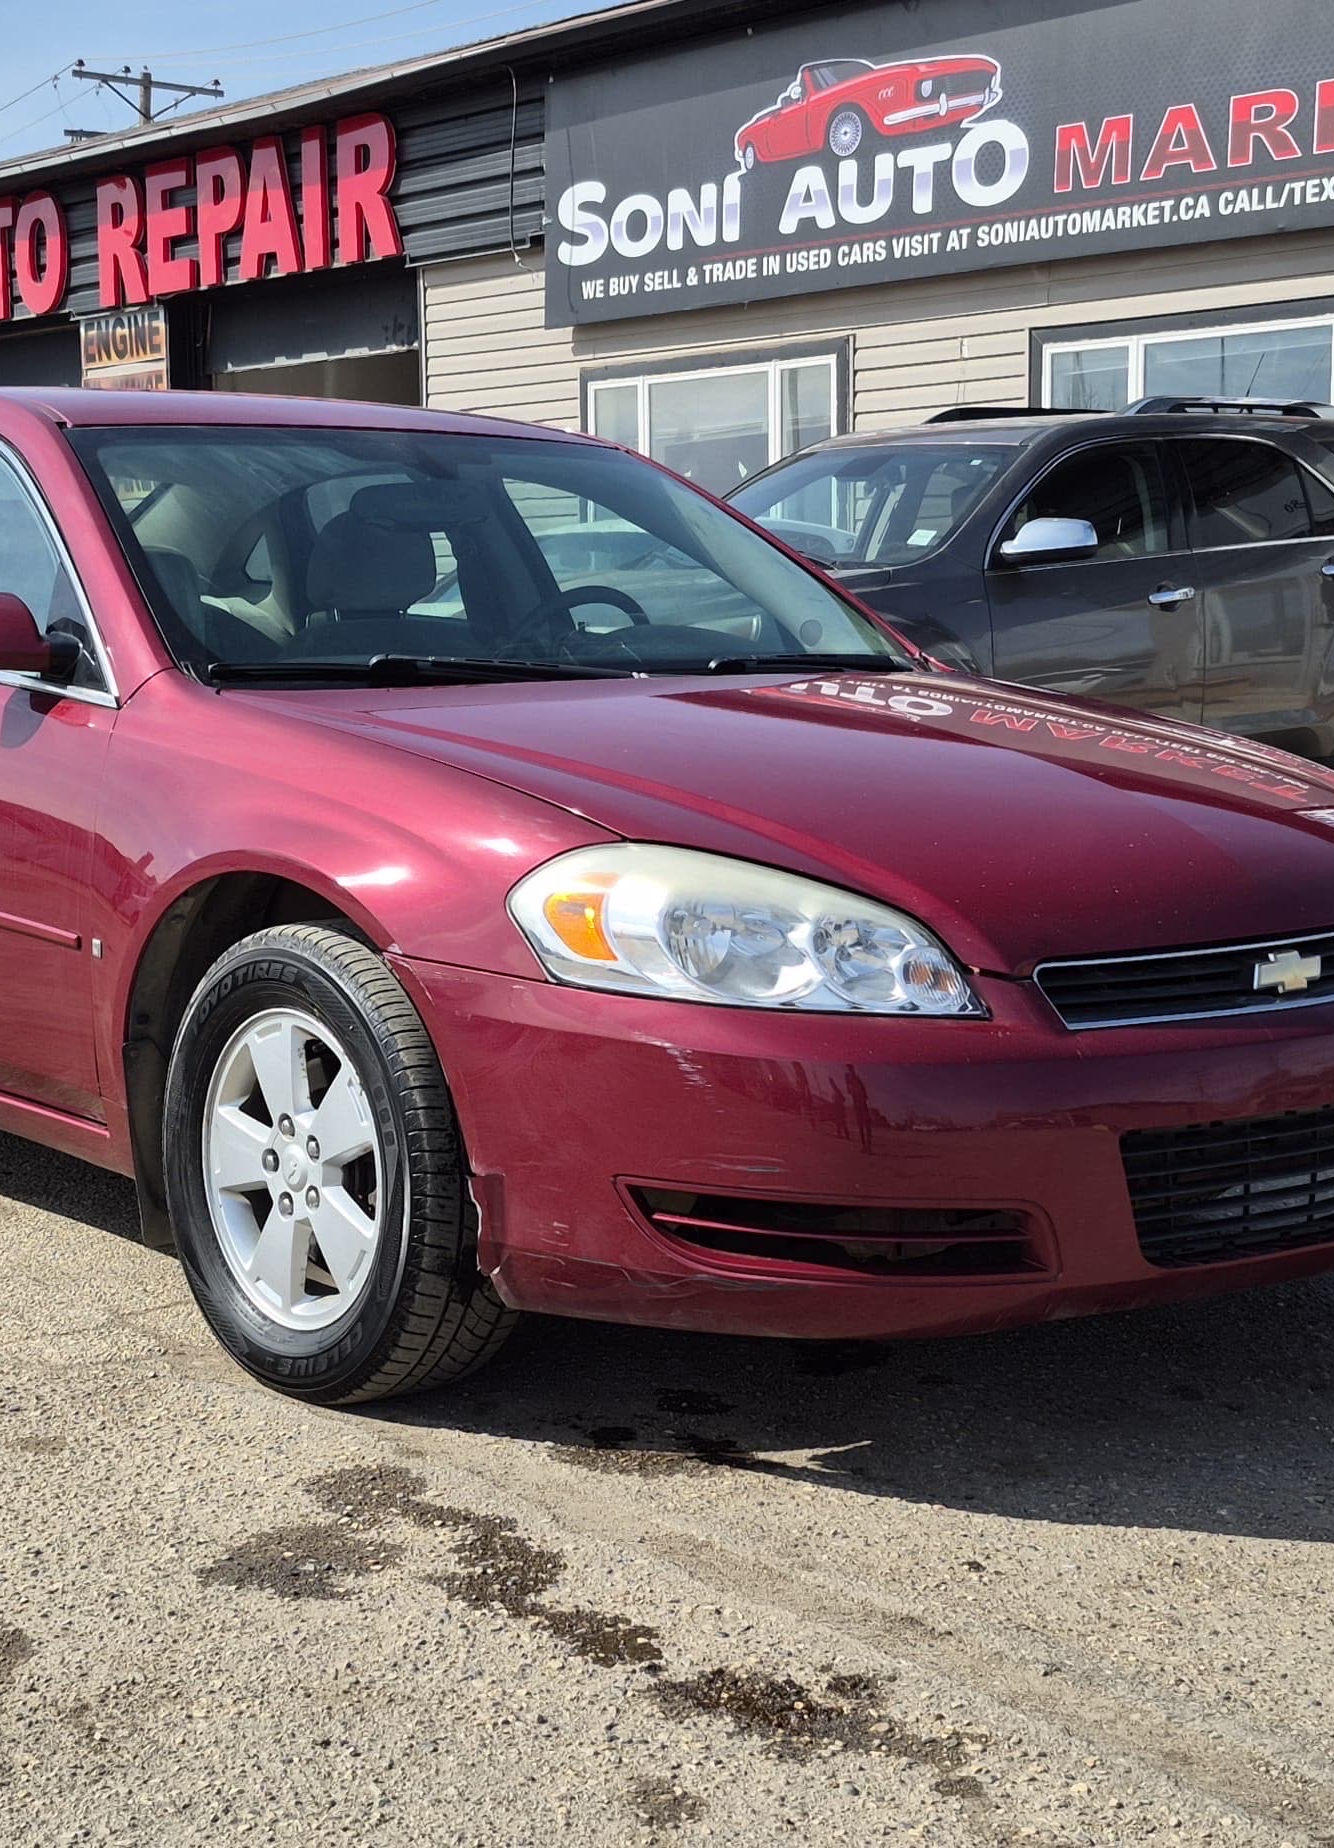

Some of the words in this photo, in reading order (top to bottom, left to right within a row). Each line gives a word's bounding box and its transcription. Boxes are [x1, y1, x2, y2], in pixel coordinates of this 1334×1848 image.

[97, 112, 405, 309] REPAIR
[557, 171, 741, 266] SONI
[778, 119, 1030, 235] AUTO
[581, 279, 604, 300] WE
[609, 274, 640, 297] BUY
[643, 269, 682, 292] SELL
[686, 266, 699, 287] &
[703, 258, 757, 284] TRADE
[762, 255, 780, 277] IN
[785, 247, 832, 273] USED
[837, 240, 887, 267] CARS
[892, 232, 942, 259] VISIT
[946, 228, 971, 252] AT
[976, 195, 1211, 248] SONIAUTOMARKET.CA
[84, 311, 162, 364] ENGINE
[235, 962, 299, 986] TIRES
